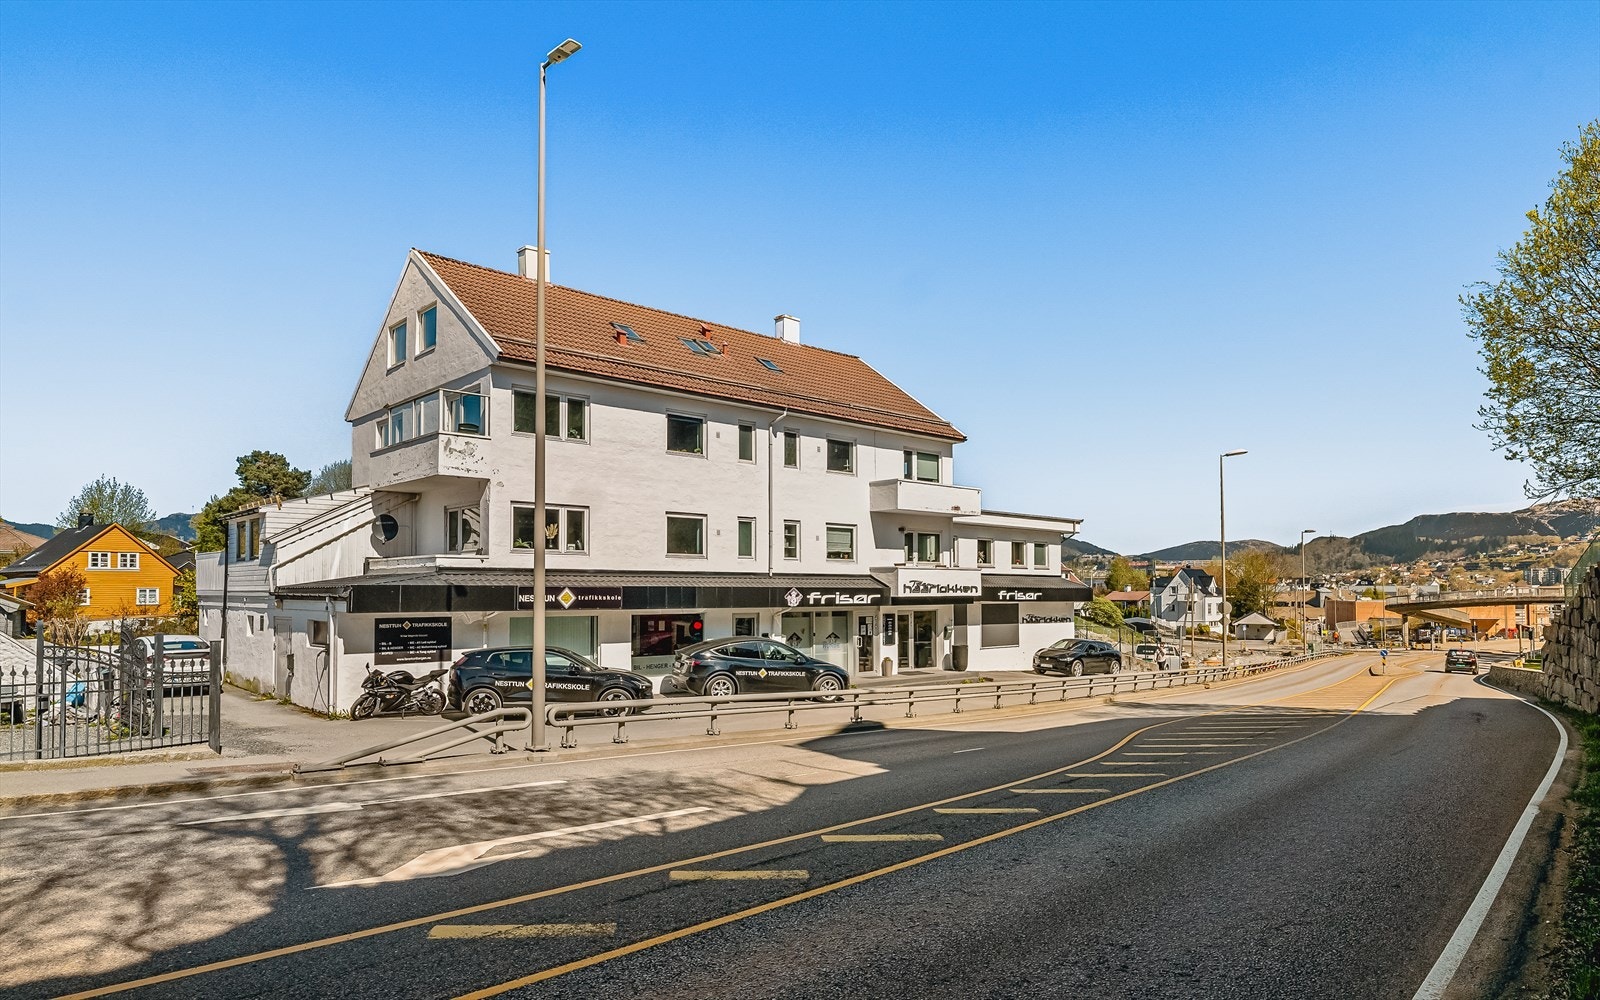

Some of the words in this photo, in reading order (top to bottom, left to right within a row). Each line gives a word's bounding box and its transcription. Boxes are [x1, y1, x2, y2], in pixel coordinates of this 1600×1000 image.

[518, 594, 556, 602] NESUN
[494, 680, 525, 688] NESTTUN
[544, 682, 590, 691] RAFIKKSKOLE
